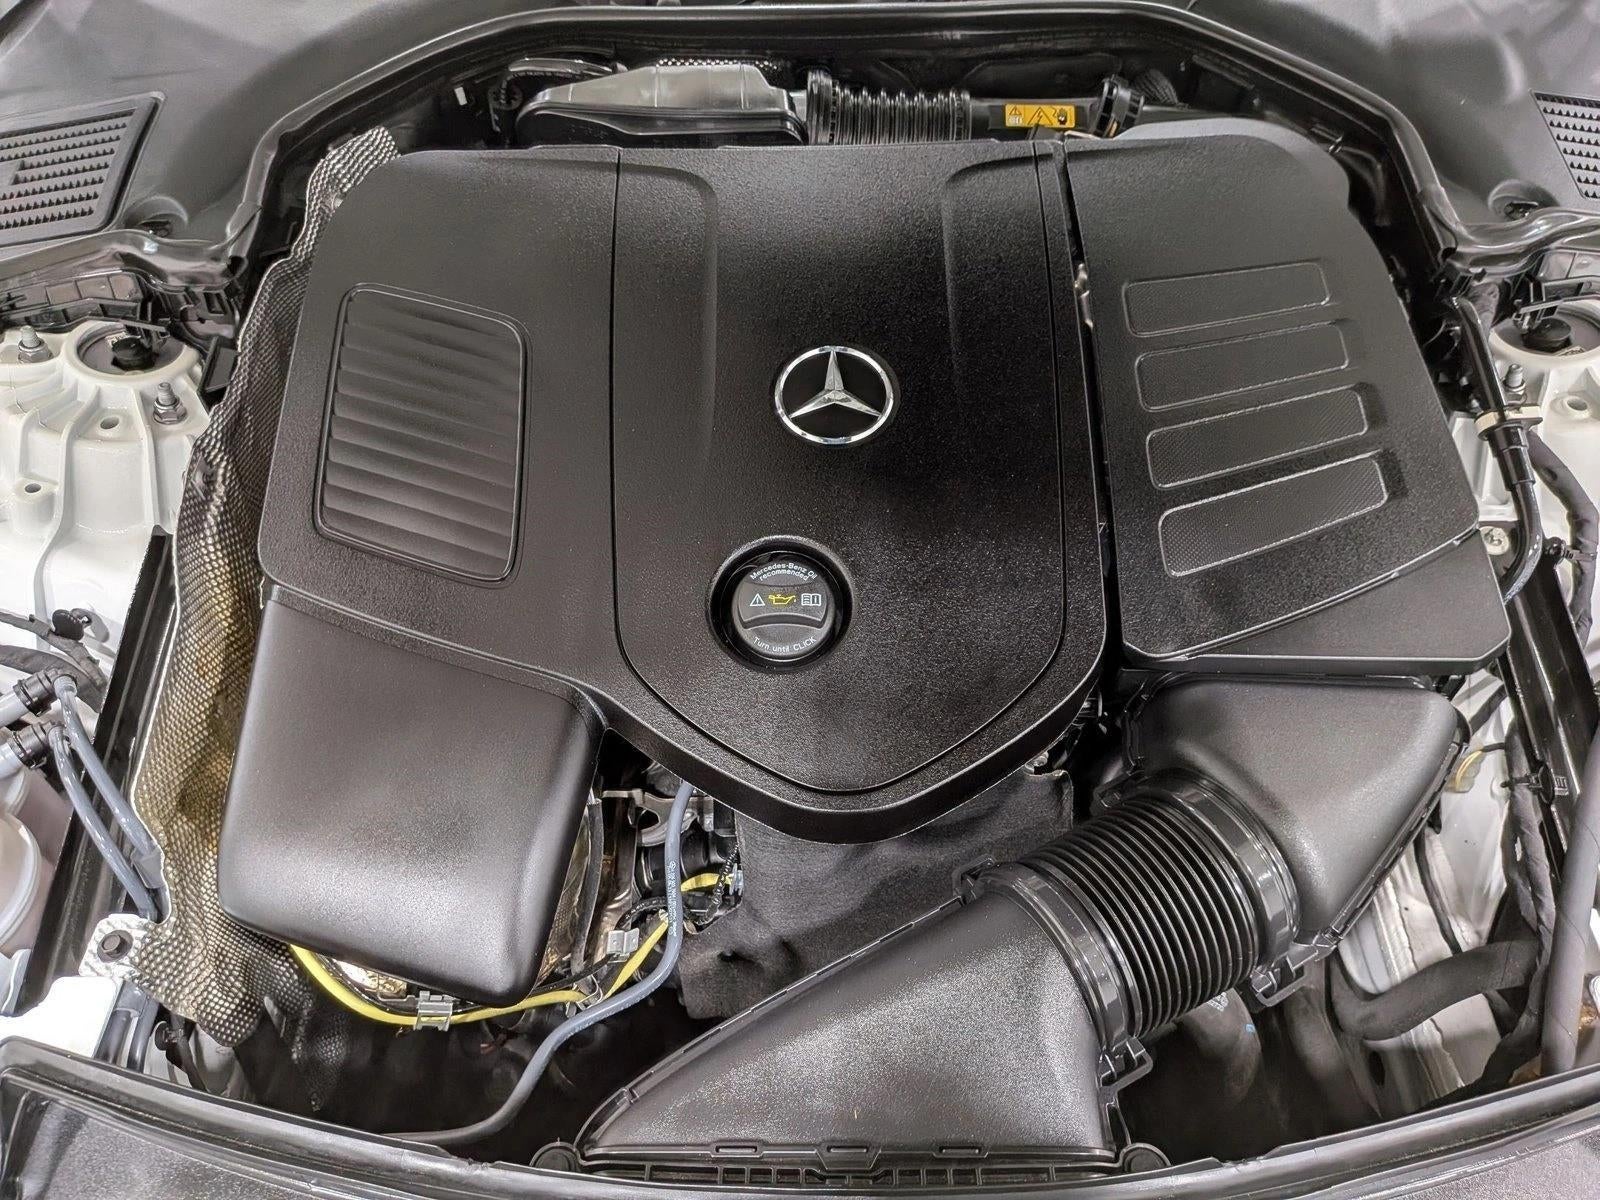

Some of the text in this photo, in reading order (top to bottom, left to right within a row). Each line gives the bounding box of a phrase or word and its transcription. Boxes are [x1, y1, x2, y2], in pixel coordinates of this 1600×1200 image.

[750, 562, 818, 580] Mercedes-Benz Oil
[759, 568, 809, 581] recommended
[753, 636, 770, 650] Turn
[793, 636, 817, 651] CLICK
